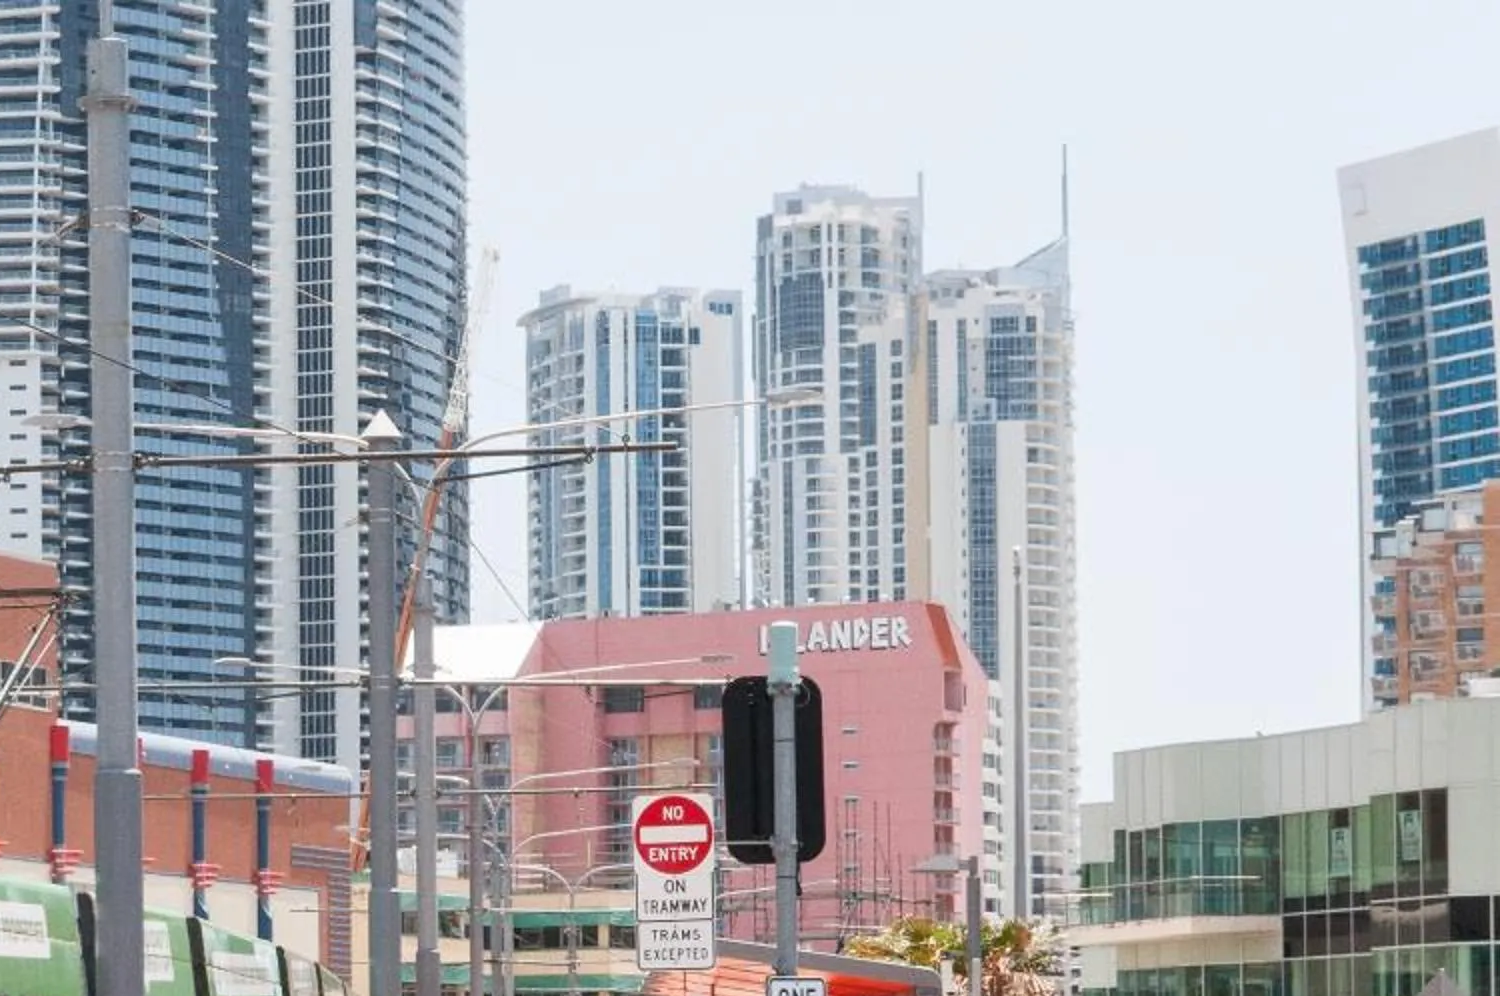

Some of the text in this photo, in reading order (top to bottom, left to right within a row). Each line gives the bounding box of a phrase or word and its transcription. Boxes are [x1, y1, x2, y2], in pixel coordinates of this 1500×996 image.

[759, 616, 913, 655] ILANDER
[662, 805, 685, 821] NO
[649, 845, 699, 862] ENTRY
[664, 879, 687, 893] ON
[642, 899, 708, 915] TRAMWAY
[651, 928, 702, 941] TRAMS
[643, 947, 709, 962] EXCEPTED
